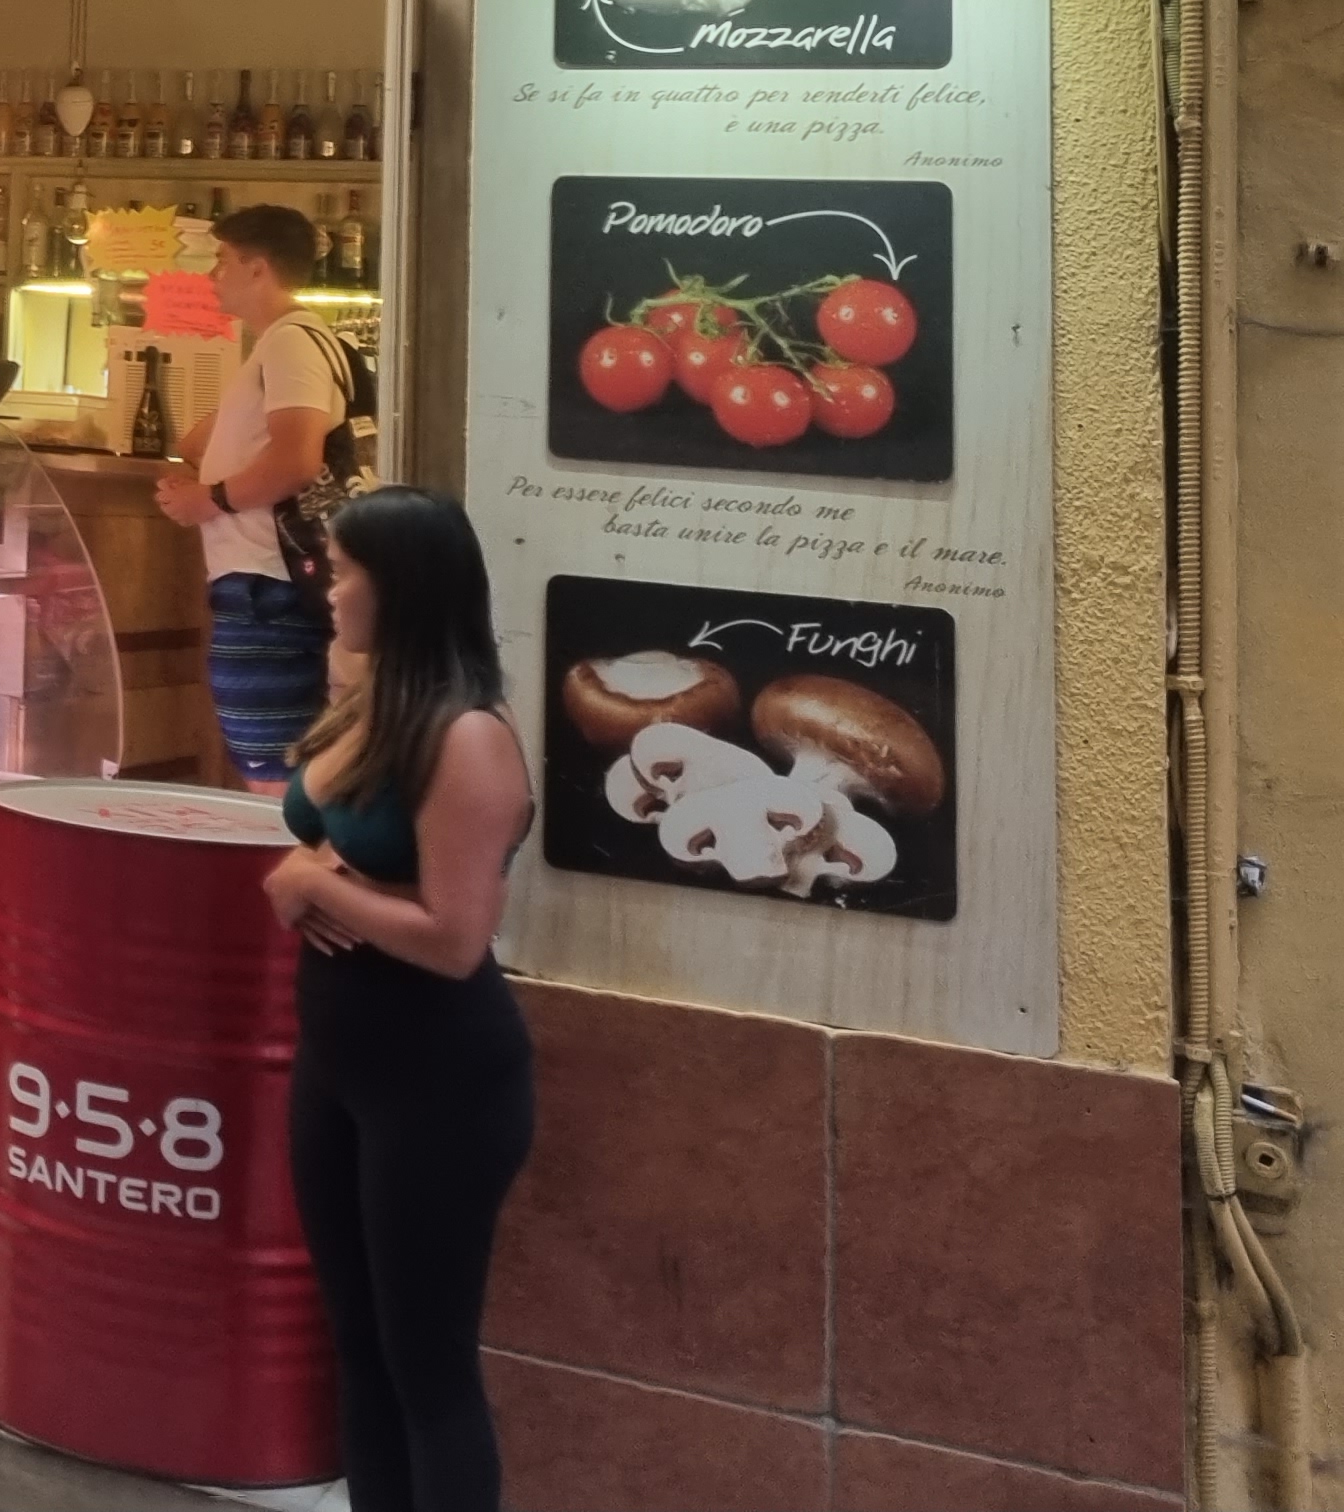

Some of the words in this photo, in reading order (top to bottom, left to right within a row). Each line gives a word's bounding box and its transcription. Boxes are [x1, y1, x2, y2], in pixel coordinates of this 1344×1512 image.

[690, 15, 896, 55] Mozzarella
[512, 83, 539, 103] Se
[548, 84, 568, 103] si
[575, 82, 602, 110] fa
[611, 85, 640, 103] in
[651, 84, 740, 110] quattro
[745, 88, 789, 109] per
[802, 83, 902, 104] renderti
[906, 83, 987, 110] felice,
[746, 120, 795, 134] una
[800, 117, 885, 141] pizza.
[902, 150, 1004, 168] Anonimo
[602, 201, 763, 238] Pomodoro
[506, 477, 544, 497] Per
[551, 486, 622, 504] essere
[625, 486, 696, 511] felici
[701, 494, 803, 517] secondo
[814, 504, 856, 521] me
[603, 512, 669, 538] basta
[677, 521, 746, 545] unire
[755, 526, 781, 547] la
[785, 531, 865, 561] pizza
[873, 541, 891, 555] e
[898, 536, 923, 558] il
[932, 544, 1008, 567] mare.
[903, 573, 1008, 599] Anonimo
[784, 622, 923, 668] Funghi
[8, 1145, 220, 1220] SANTERO
